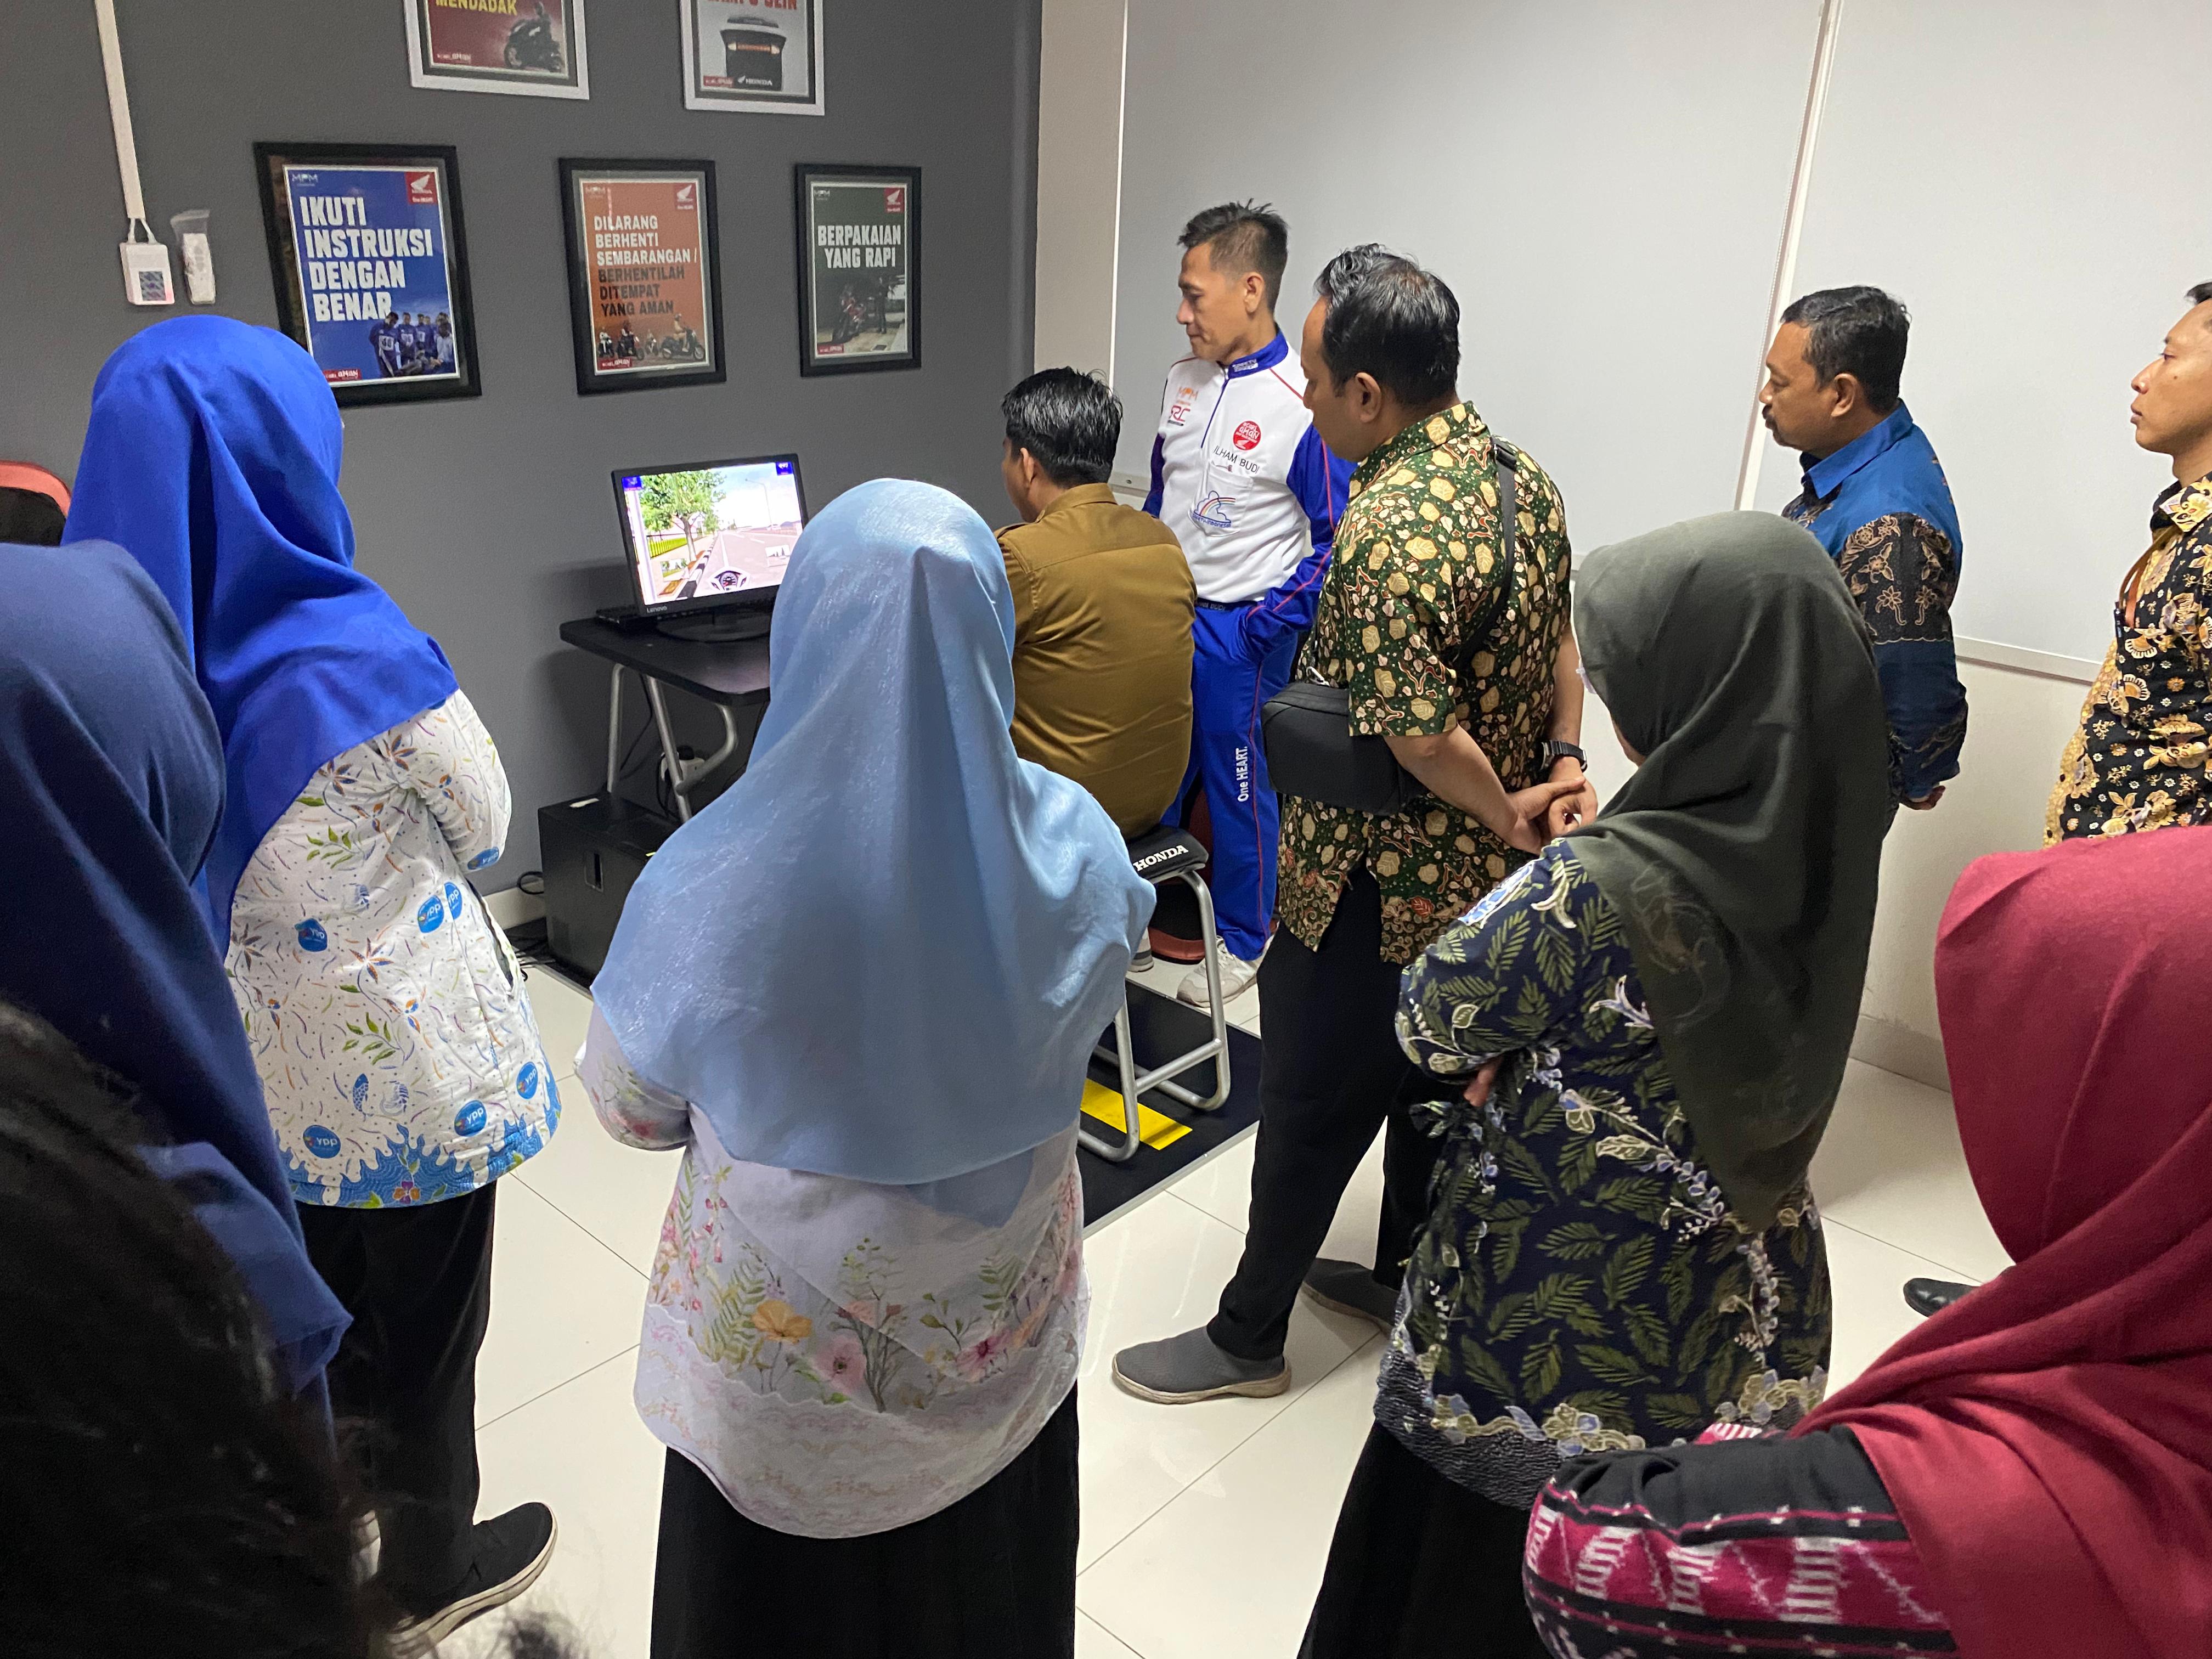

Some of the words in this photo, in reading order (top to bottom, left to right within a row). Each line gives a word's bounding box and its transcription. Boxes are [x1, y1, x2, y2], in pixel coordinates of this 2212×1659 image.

[300, 196, 366, 227] IKUTI
[594, 215, 658, 231] DILARANG
[303, 228, 433, 258] INSTRUKSI
[595, 232, 658, 249] BERHENTI
[817, 224, 901, 246] BERPAKAIAN
[596, 249, 691, 267] SEMBARANGAN
[824, 247, 861, 269] YANG
[865, 247, 896, 268] RAPI
[308, 259, 406, 291] DENGAN
[597, 266, 685, 283] BERHENTILAH
[599, 284, 660, 301] DITEMPAT
[313, 291, 392, 323] BENAR
[601, 301, 635, 317] YANG
[639, 301, 674, 315] AMAN
[1213, 445, 1238, 464] ILHAM
[1239, 458, 1260, 474] BUDI
[1235, 746, 1249, 781] HEART.
[1237, 781, 1249, 802] One
[1132, 845, 1189, 872] HONDA
